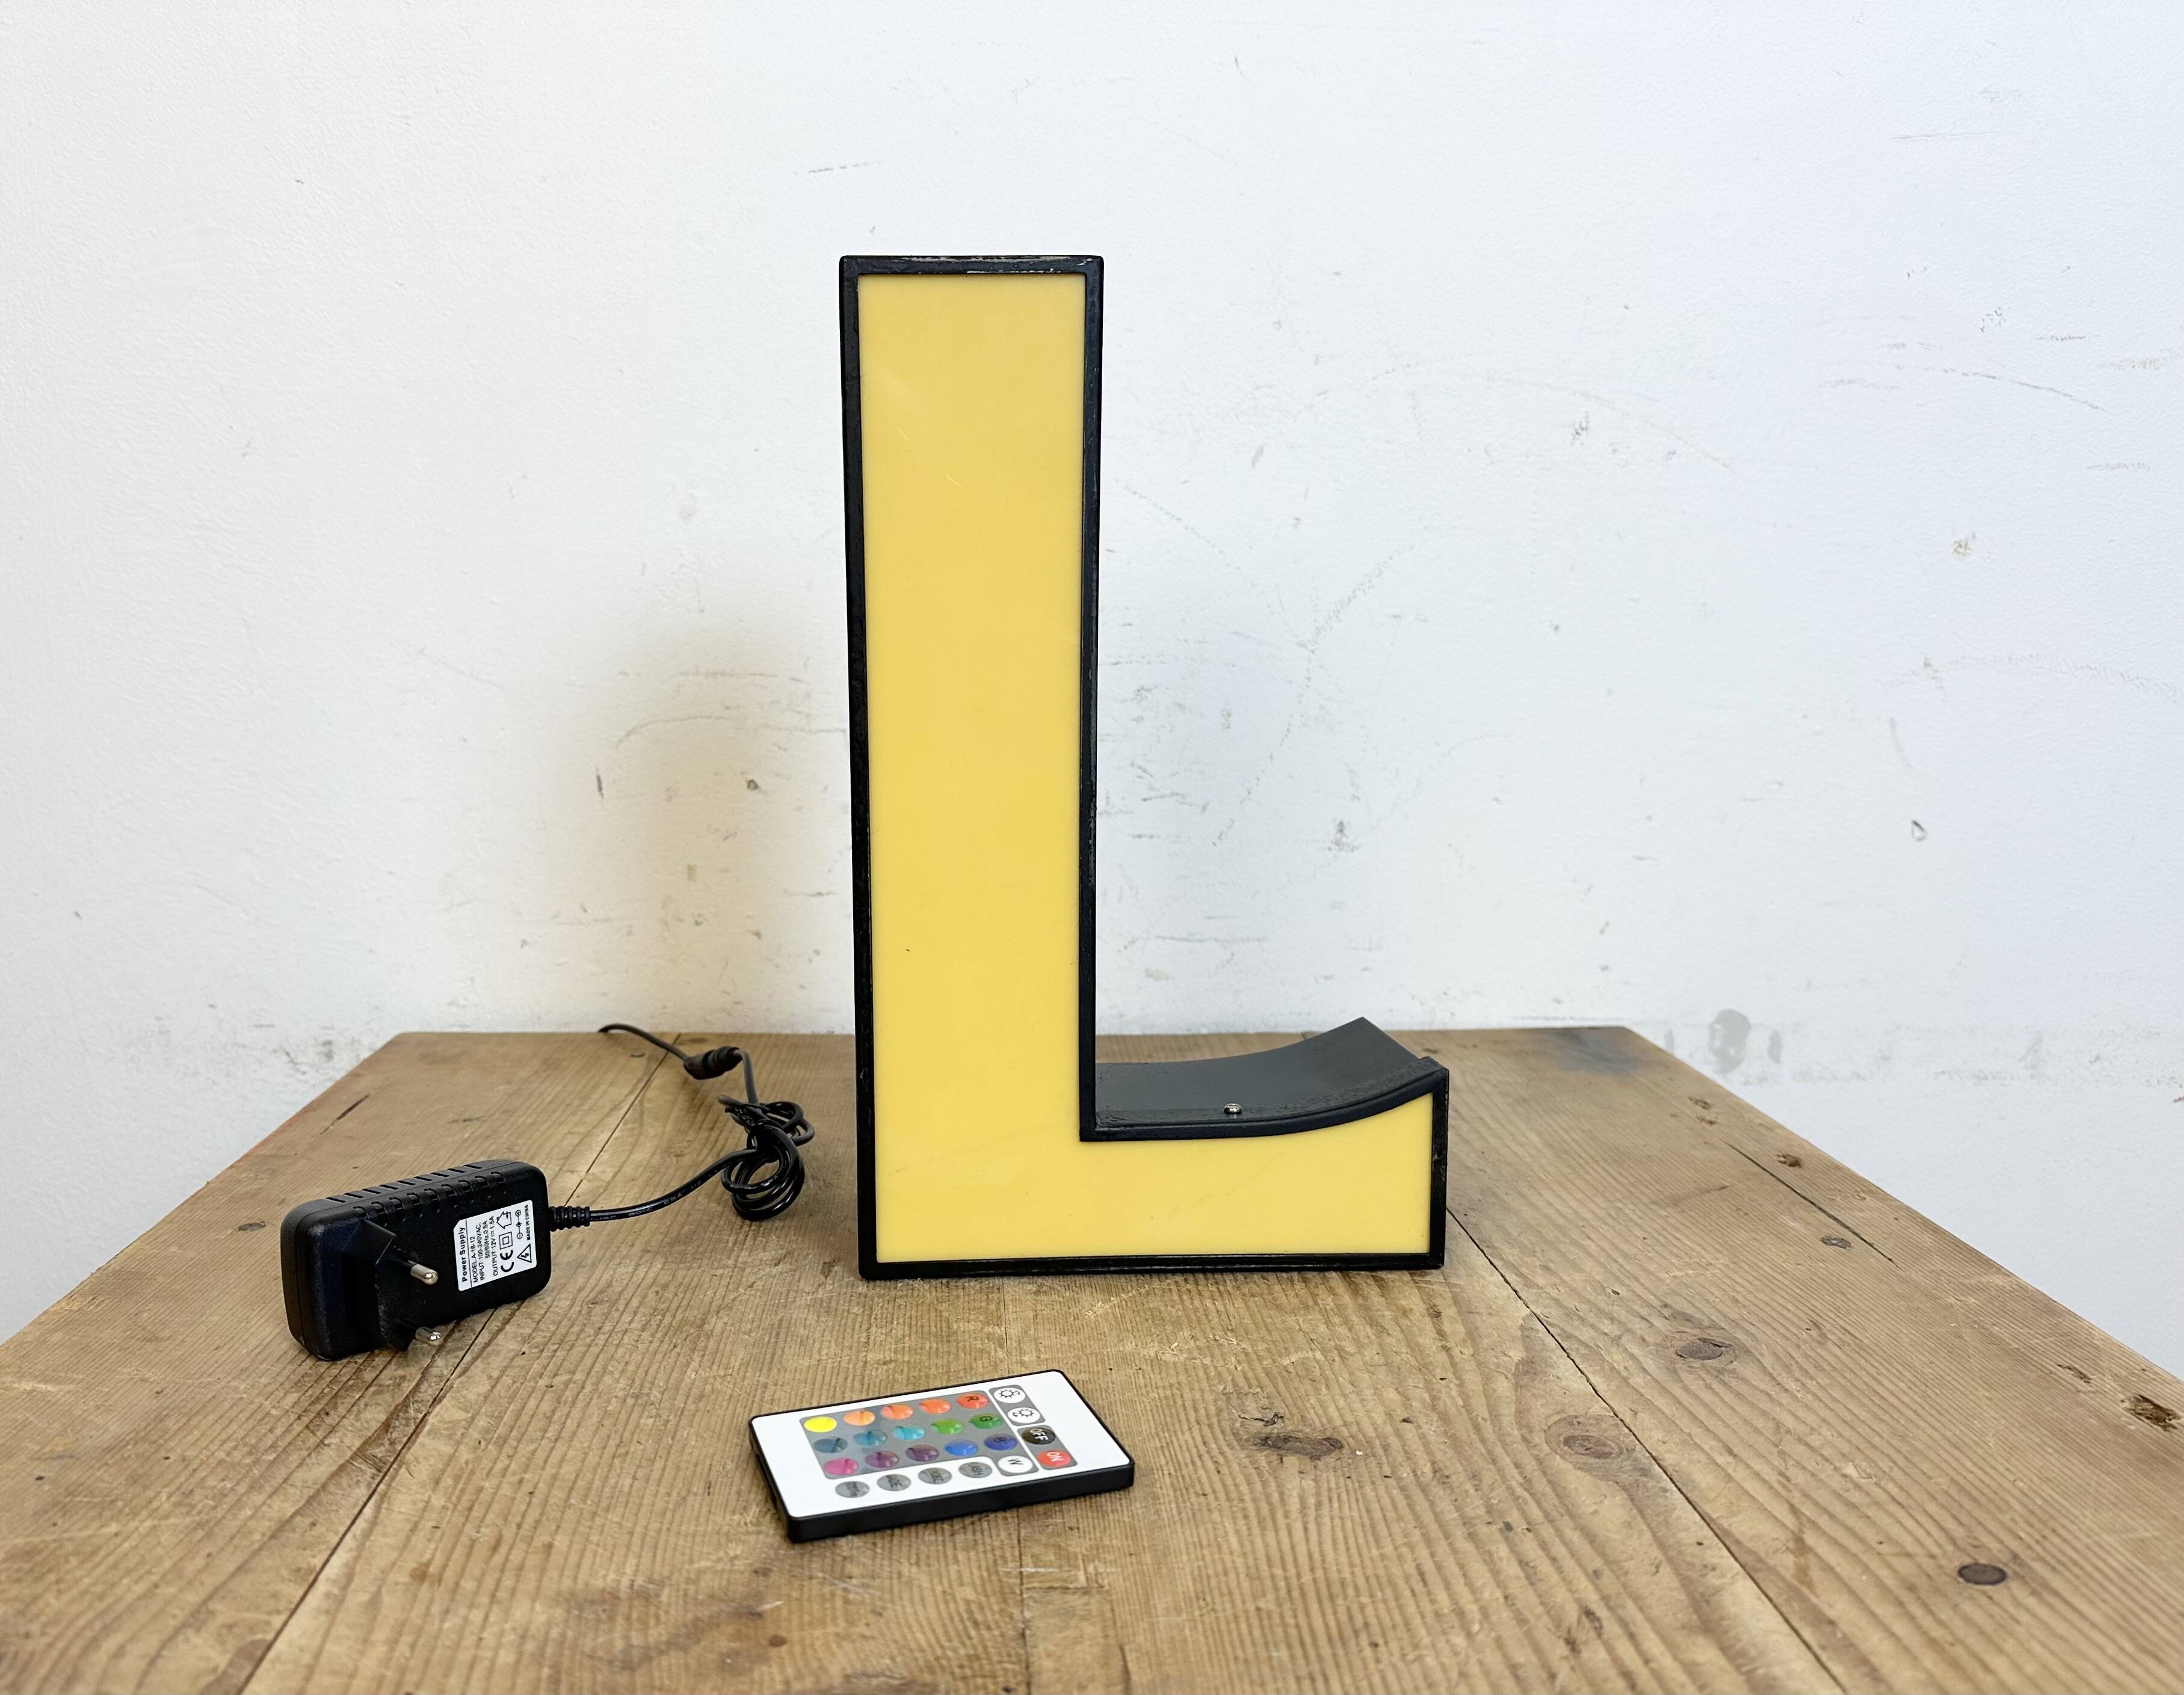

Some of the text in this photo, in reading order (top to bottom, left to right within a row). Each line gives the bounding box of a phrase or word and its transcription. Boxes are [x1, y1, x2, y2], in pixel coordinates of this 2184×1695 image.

[839, 255, 1449, 1279] L
[1029, 1428, 1049, 1441] OFF
[1046, 1451, 1064, 1462] ON
